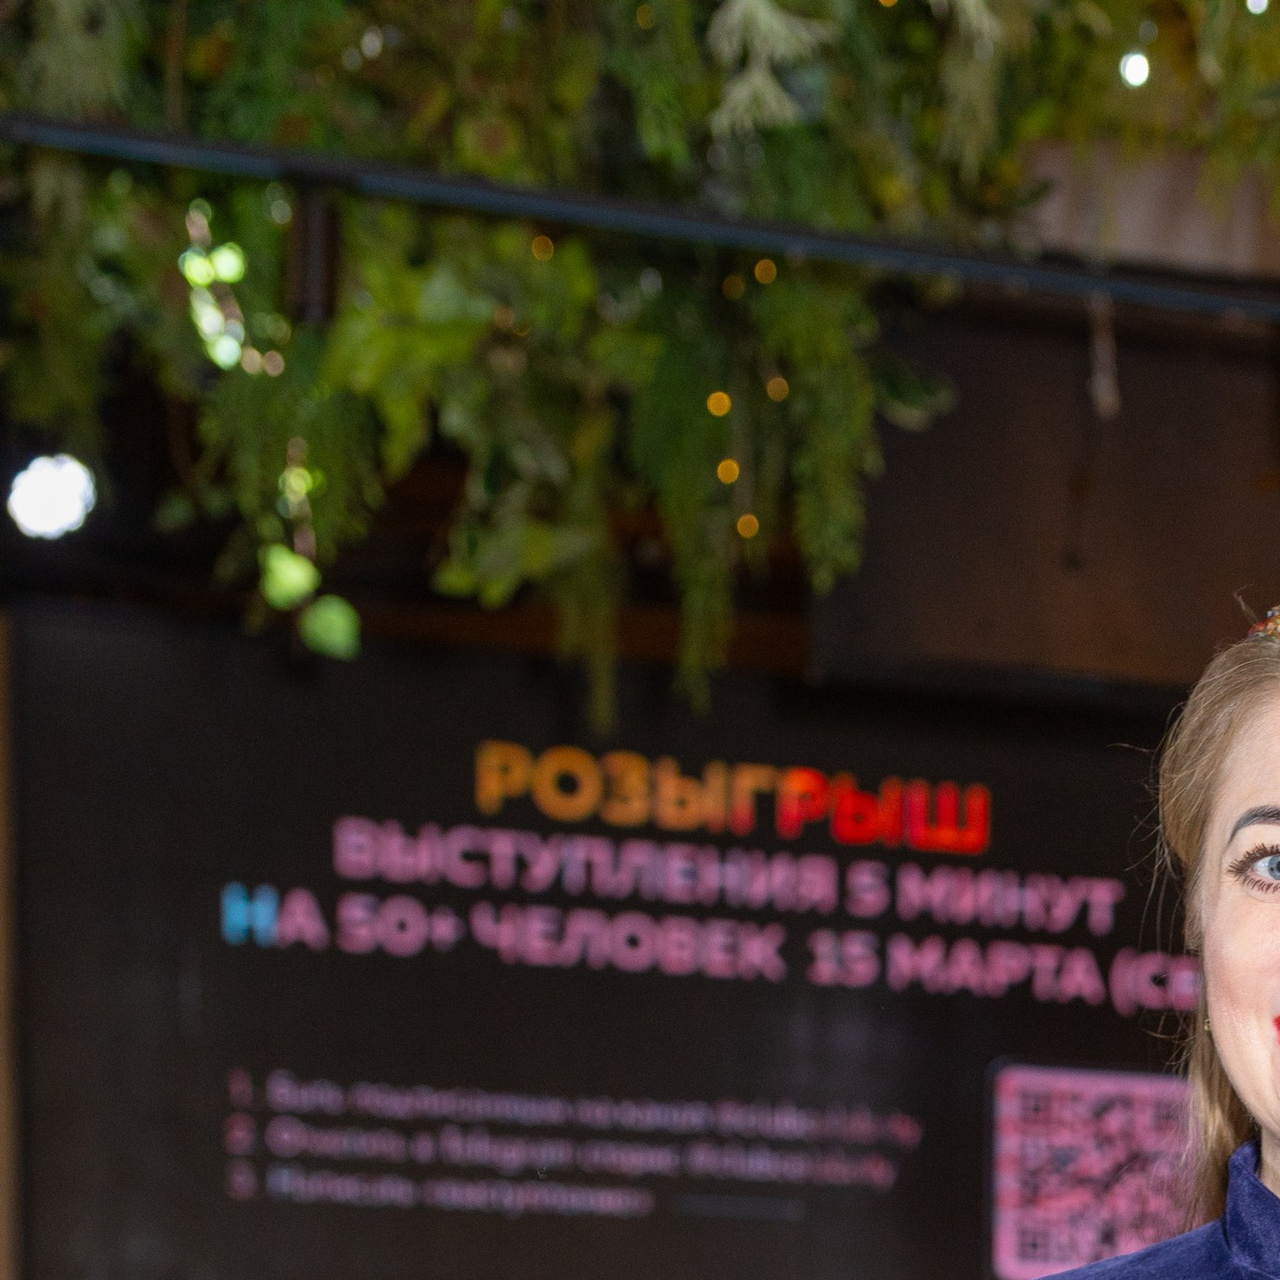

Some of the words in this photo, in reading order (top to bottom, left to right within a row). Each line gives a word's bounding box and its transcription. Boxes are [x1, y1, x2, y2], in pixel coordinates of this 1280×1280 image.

[475, 739, 992, 855] РОЗЫГРЫШ
[333, 815, 839, 915] ВЫСТУПЛЕНИЯ
[845, 858, 890, 918] 5
[897, 861, 1124, 936] МИНУТ
[221, 880, 330, 951] НА
[469, 900, 787, 984] ЧЕЛОВЕК
[806, 928, 880, 988] 15
[886, 933, 1107, 1007] МАРТА
